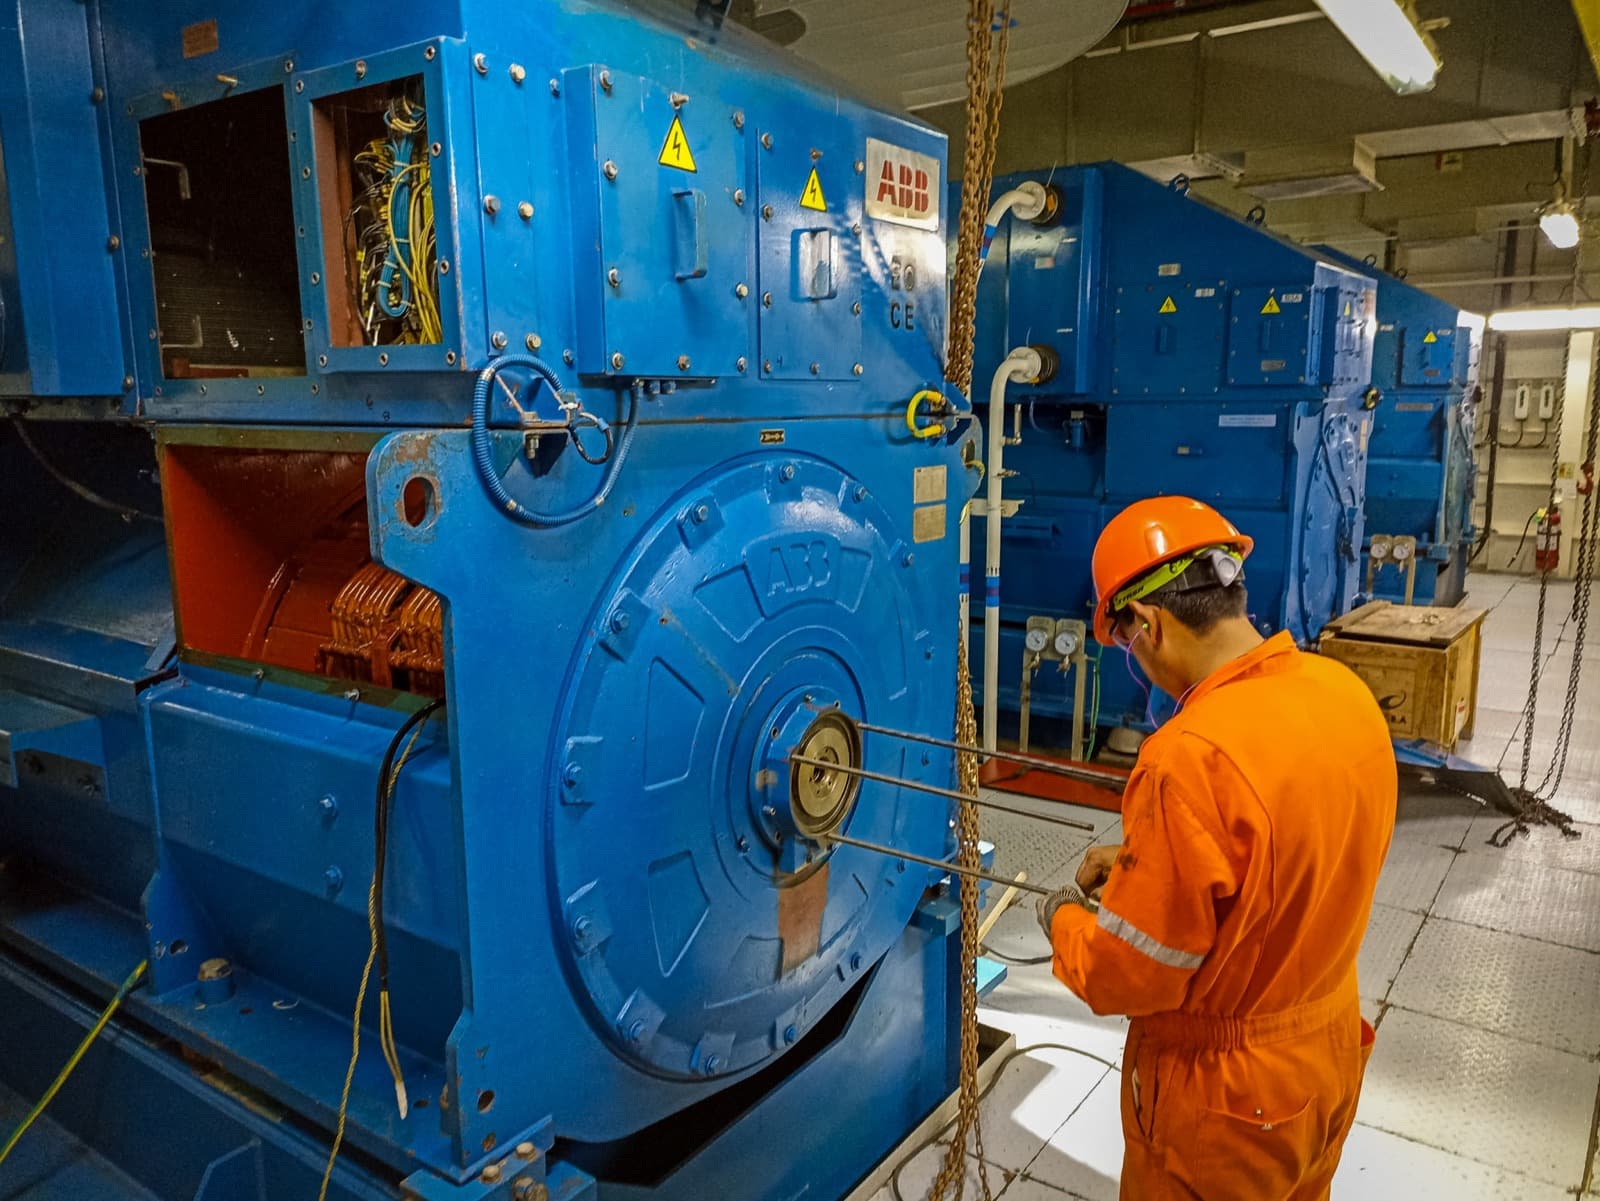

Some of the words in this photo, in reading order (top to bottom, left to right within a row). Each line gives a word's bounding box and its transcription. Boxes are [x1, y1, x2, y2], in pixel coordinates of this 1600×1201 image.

[877, 159, 929, 213] ABB
[891, 302, 914, 330] CE
[766, 540, 831, 597] ABB
